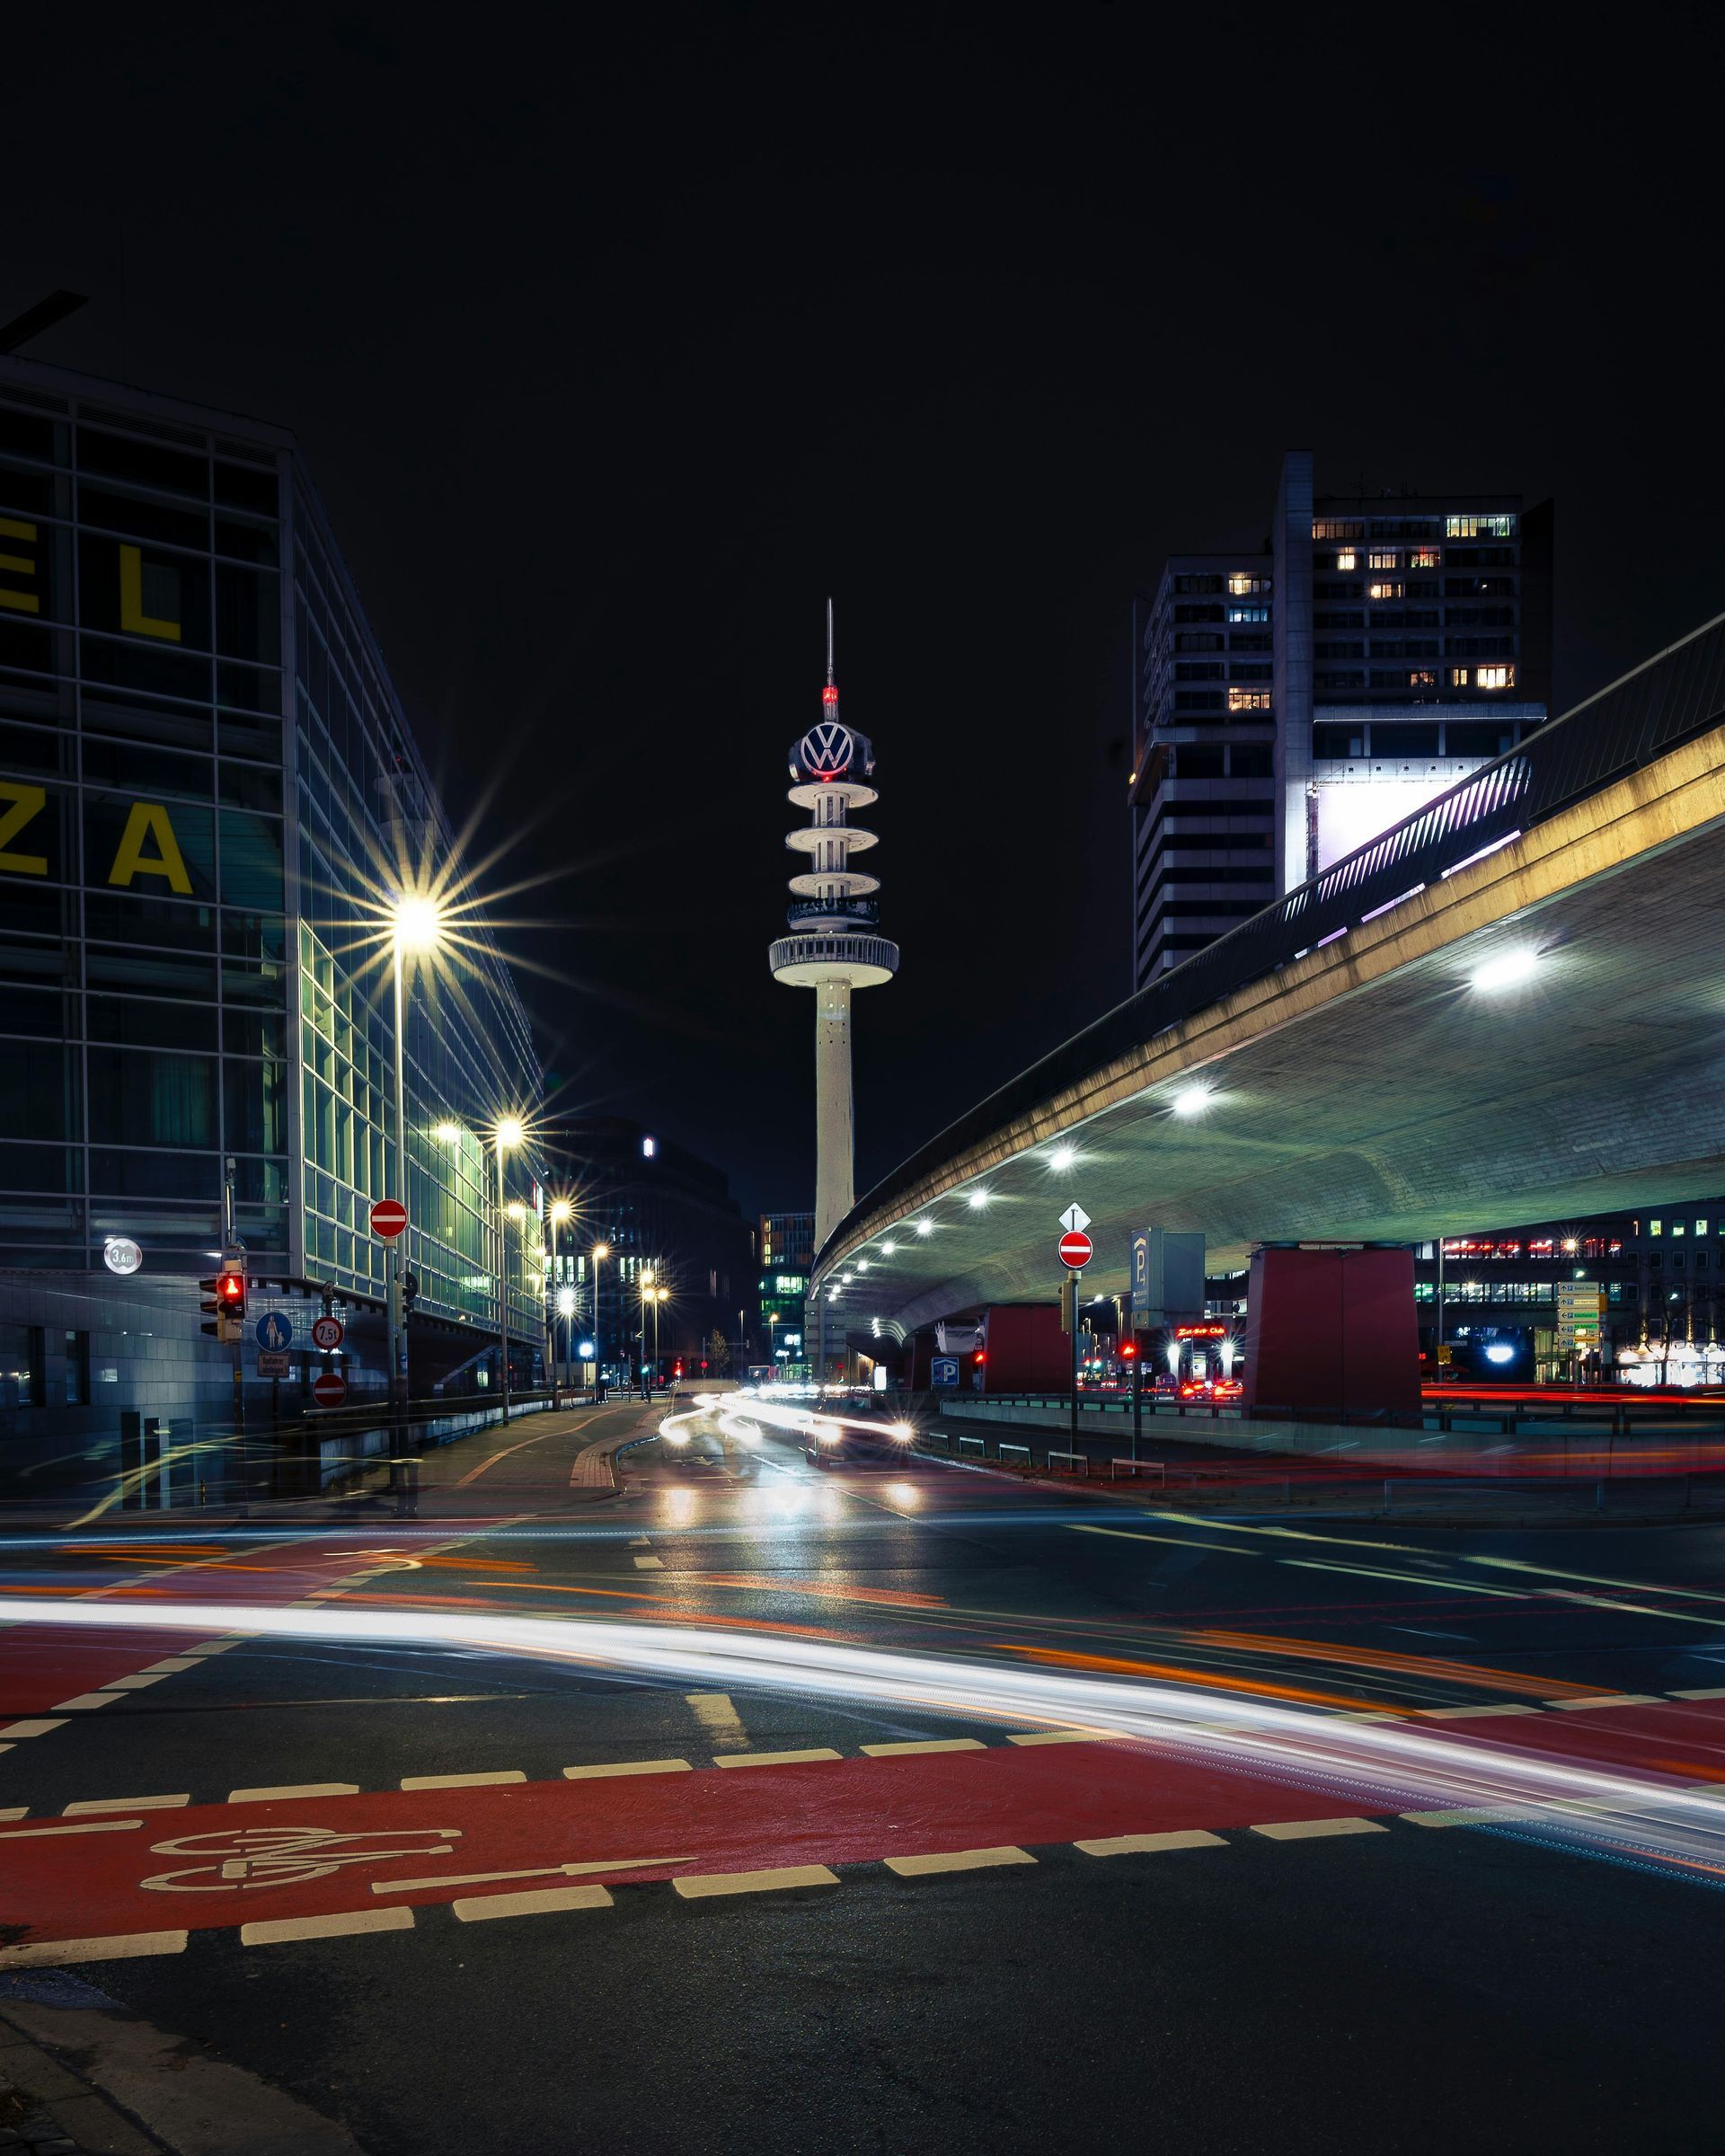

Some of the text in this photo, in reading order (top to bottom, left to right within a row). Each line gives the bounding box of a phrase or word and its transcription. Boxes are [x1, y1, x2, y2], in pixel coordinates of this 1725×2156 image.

[806, 726, 849, 769] VW
[1137, 1250, 1145, 1283] P
[944, 1365, 956, 1382] P
